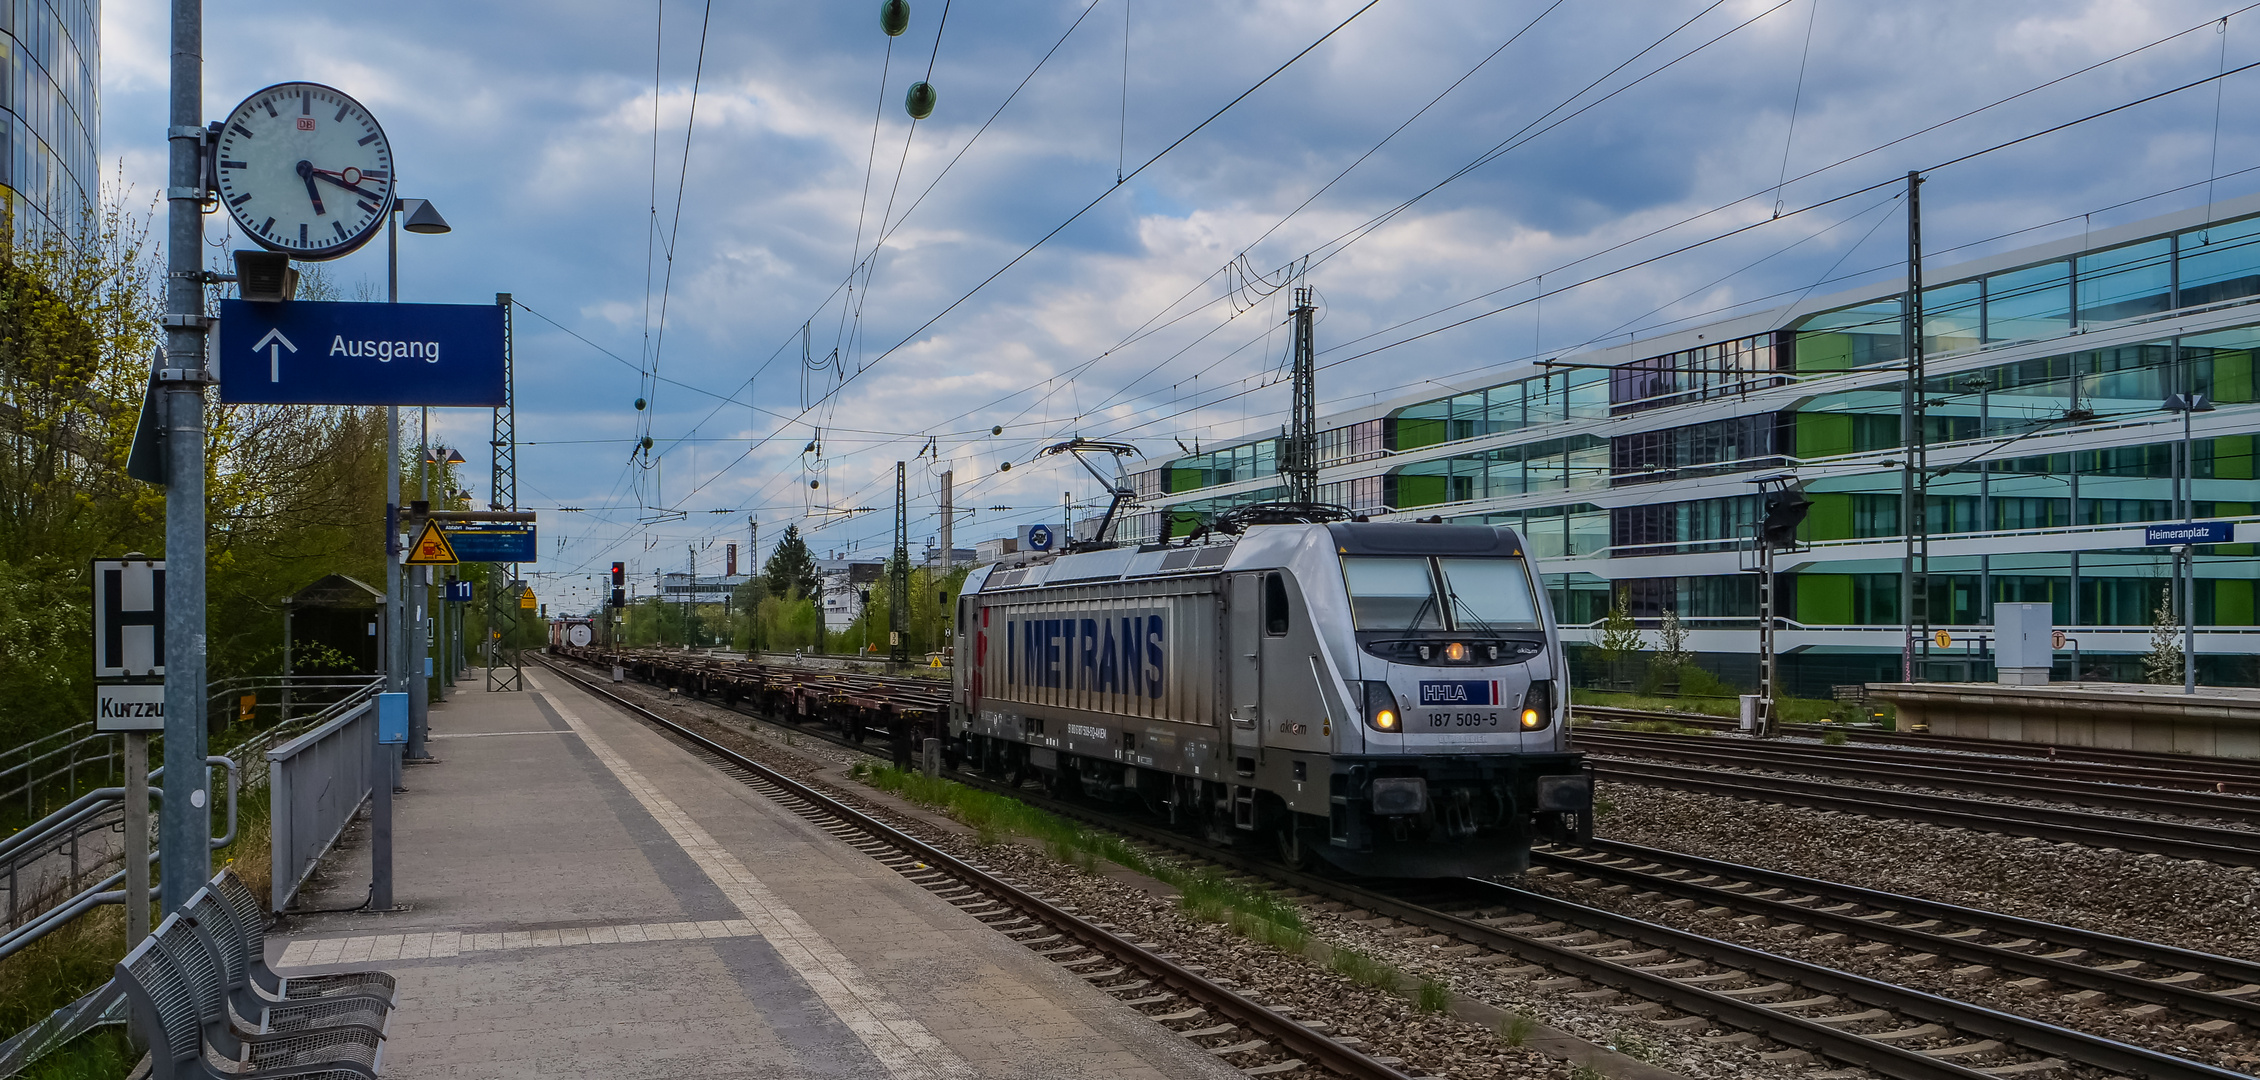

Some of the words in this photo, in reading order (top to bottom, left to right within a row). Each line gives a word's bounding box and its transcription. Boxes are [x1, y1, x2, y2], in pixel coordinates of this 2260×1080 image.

[329, 335, 440, 363] Ausgang
[2149, 527, 2209, 540] Heimeranplatz
[456, 581, 471, 597] 11
[104, 570, 166, 667] H
[1423, 685, 1468, 701] HHLA
[1280, 719, 1307, 735] akiem
[1428, 713, 1451, 727] 187
[1456, 713, 1498, 727] 509-5
